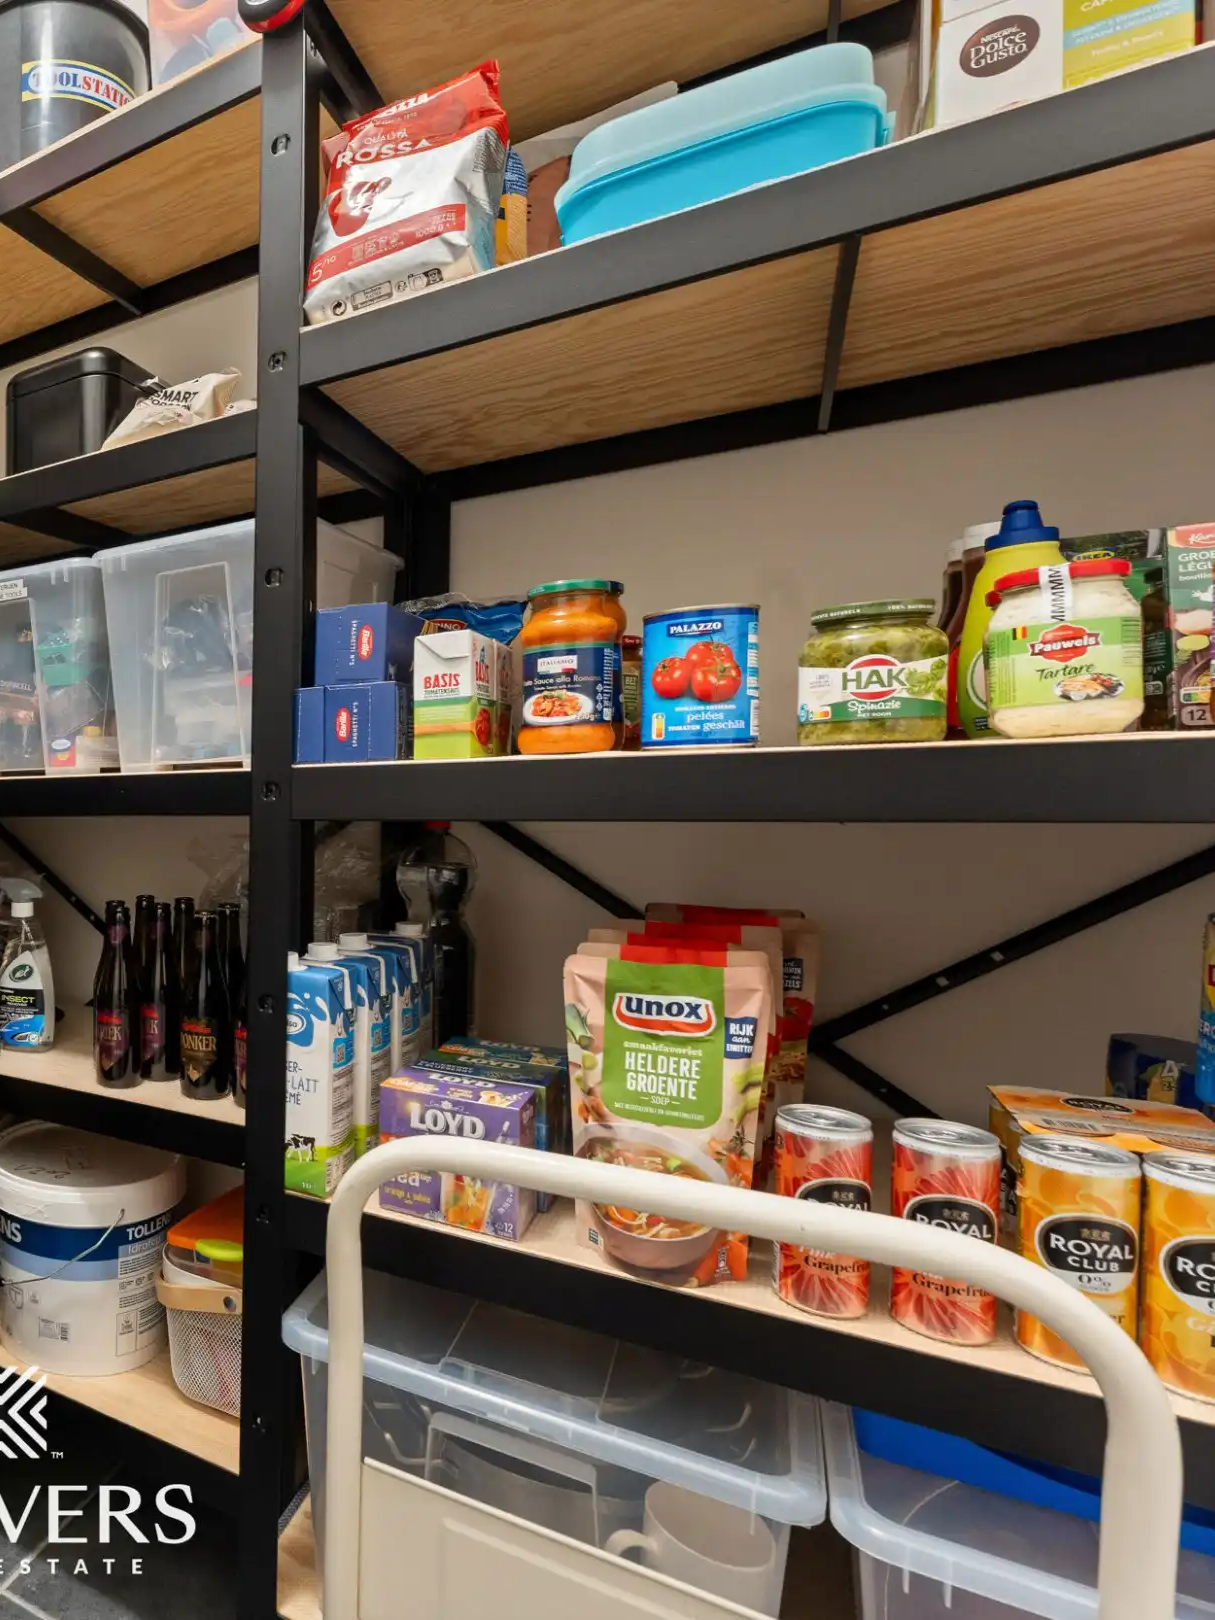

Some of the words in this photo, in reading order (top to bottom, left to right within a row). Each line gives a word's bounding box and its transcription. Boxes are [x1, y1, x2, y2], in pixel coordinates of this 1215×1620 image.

[969, 31, 1027, 60] Dolce
[969, 42, 1028, 69] Gusto
[336, 138, 432, 169] ROSSA
[669, 621, 723, 635] PALAZZO
[1033, 635, 1097, 654] Pauwels
[423, 673, 461, 689] BASIS
[534, 677, 554, 685] Sauce
[841, 667, 907, 691] HAK
[1035, 662, 1097, 681] Tartare
[847, 700, 902, 714] Spinazie
[1187, 709, 1207, 721] 12
[1, 994, 36, 1004] INSECT
[624, 995, 704, 1021] unox
[729, 1022, 755, 1037] RIJK
[731, 1036, 752, 1044] aan
[624, 1050, 702, 1080] HELDERE
[429, 1072, 497, 1089] LOYD
[626, 1071, 698, 1101] GROENTE
[409, 1101, 486, 1141] LOYD
[1049, 1232, 1134, 1260] ROYAL
[1067, 1255, 1120, 1273] CLUB
